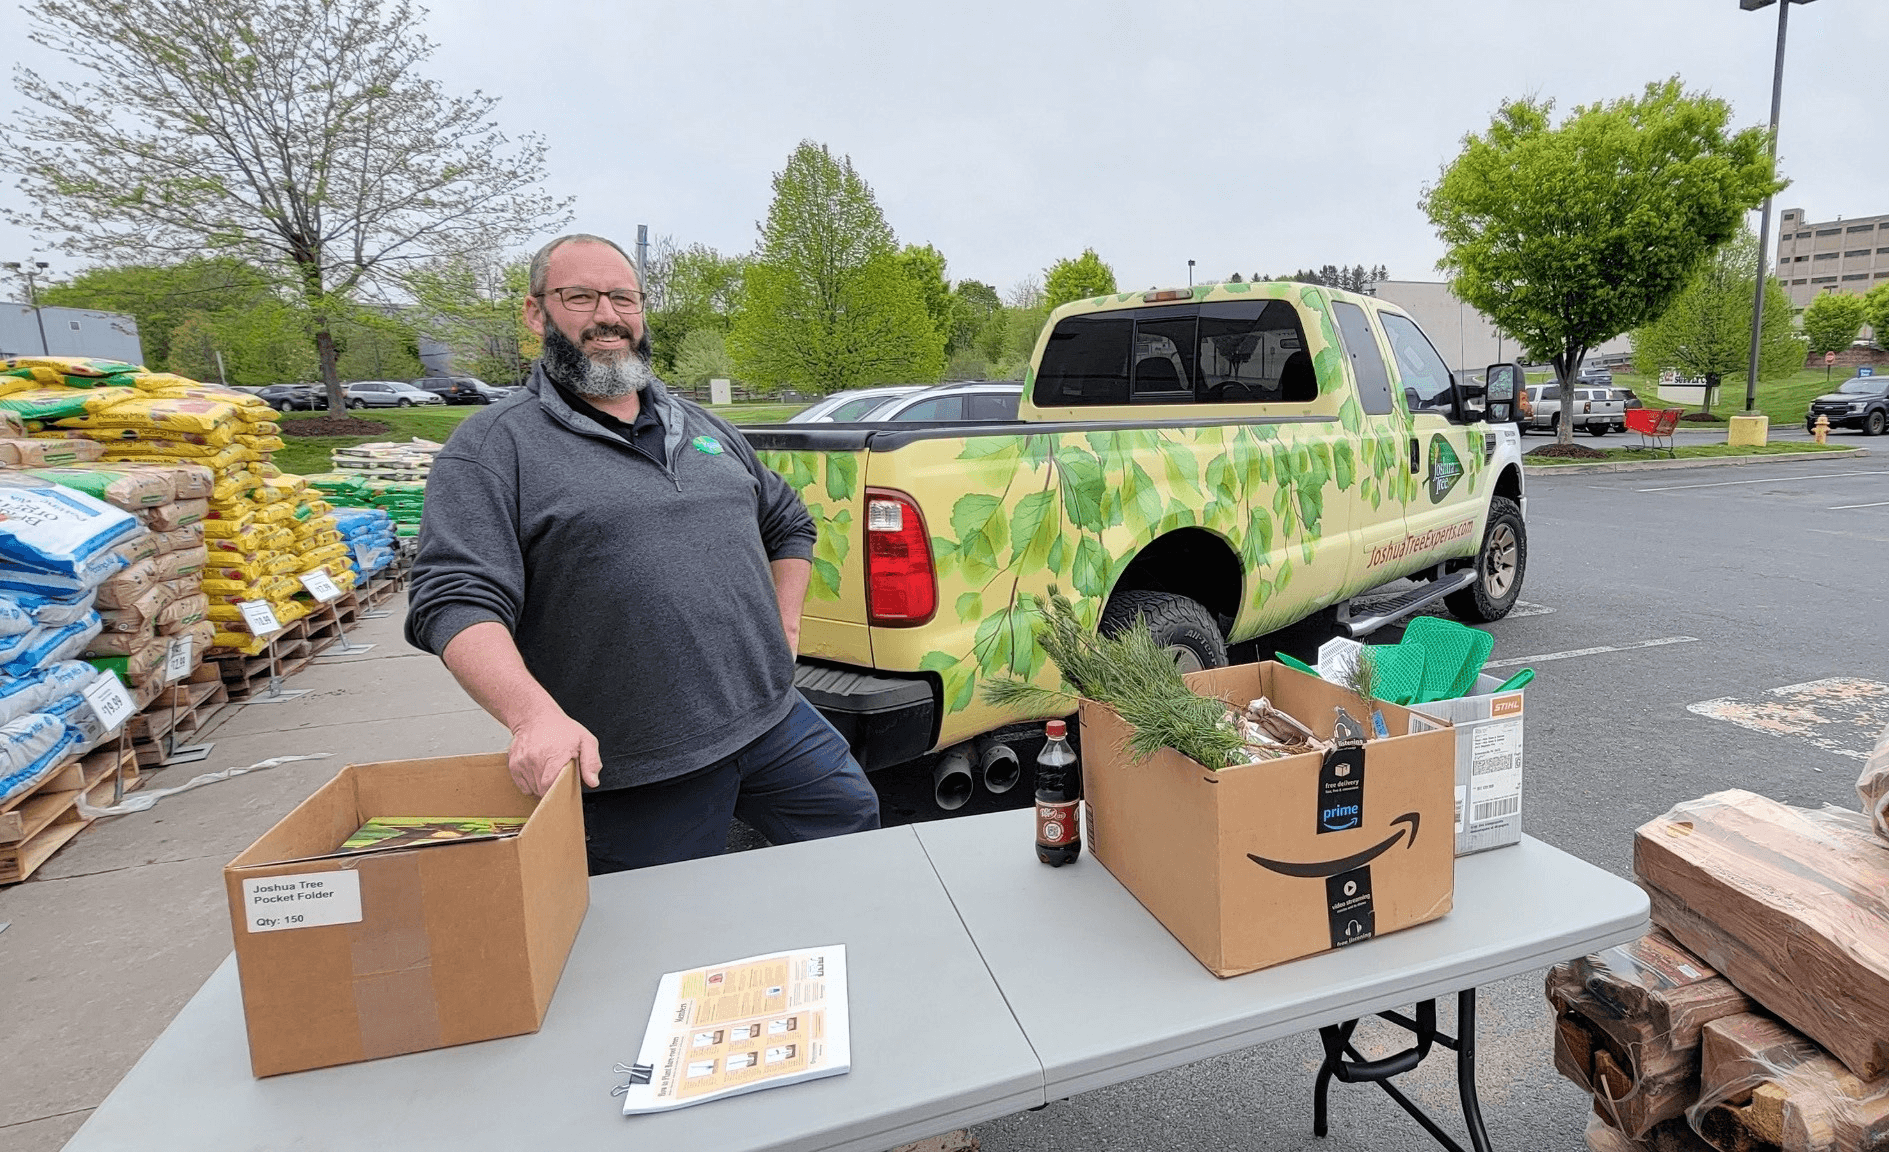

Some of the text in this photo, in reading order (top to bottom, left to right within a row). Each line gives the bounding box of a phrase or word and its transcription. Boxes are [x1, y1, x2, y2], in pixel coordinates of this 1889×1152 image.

[95, 412, 148, 421] Potting Mix
[139, 428, 169, 438] Potting
[105, 440, 133, 448] otting
[1433, 457, 1456, 482] Joshua
[1366, 520, 1474, 569] JoshuaTreeExperts.com
[1184, 629, 1218, 666] All-Terr
[1493, 701, 1520, 712] STIHL
[1325, 779, 1360, 790] free delivery
[1323, 804, 1359, 822] prime
[253, 881, 324, 894] Joshua Tree
[254, 891, 334, 904] Pocket Folder
[1332, 902, 1346, 910] video
[1346, 893, 1371, 906] streaming
[256, 914, 304, 927] Qty: 150
[1348, 932, 1372, 944] listening
[669, 1036, 680, 1048] Trees
[664, 1047, 676, 1068] Bare-root
[661, 1068, 672, 1081] Plant
[657, 1086, 668, 1097] How
